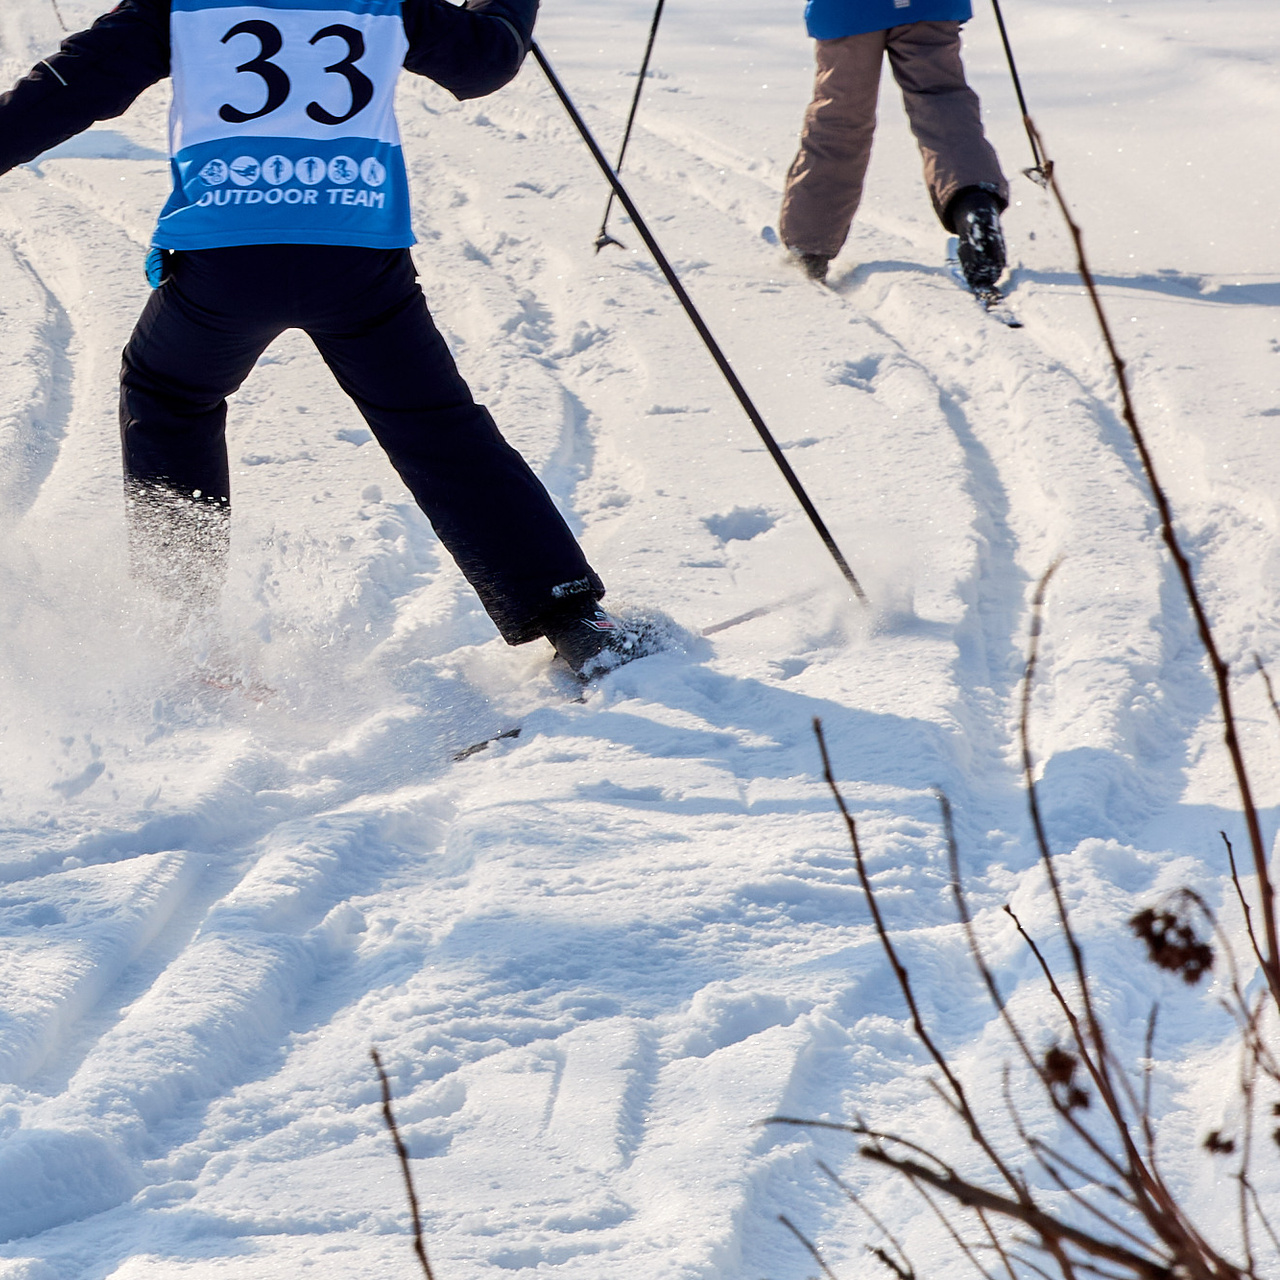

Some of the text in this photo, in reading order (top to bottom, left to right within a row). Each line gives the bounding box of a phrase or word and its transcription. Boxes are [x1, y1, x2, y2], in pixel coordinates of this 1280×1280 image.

[218, 19, 374, 126] 33
[199, 187, 385, 209] OUTDOOR TEAM
